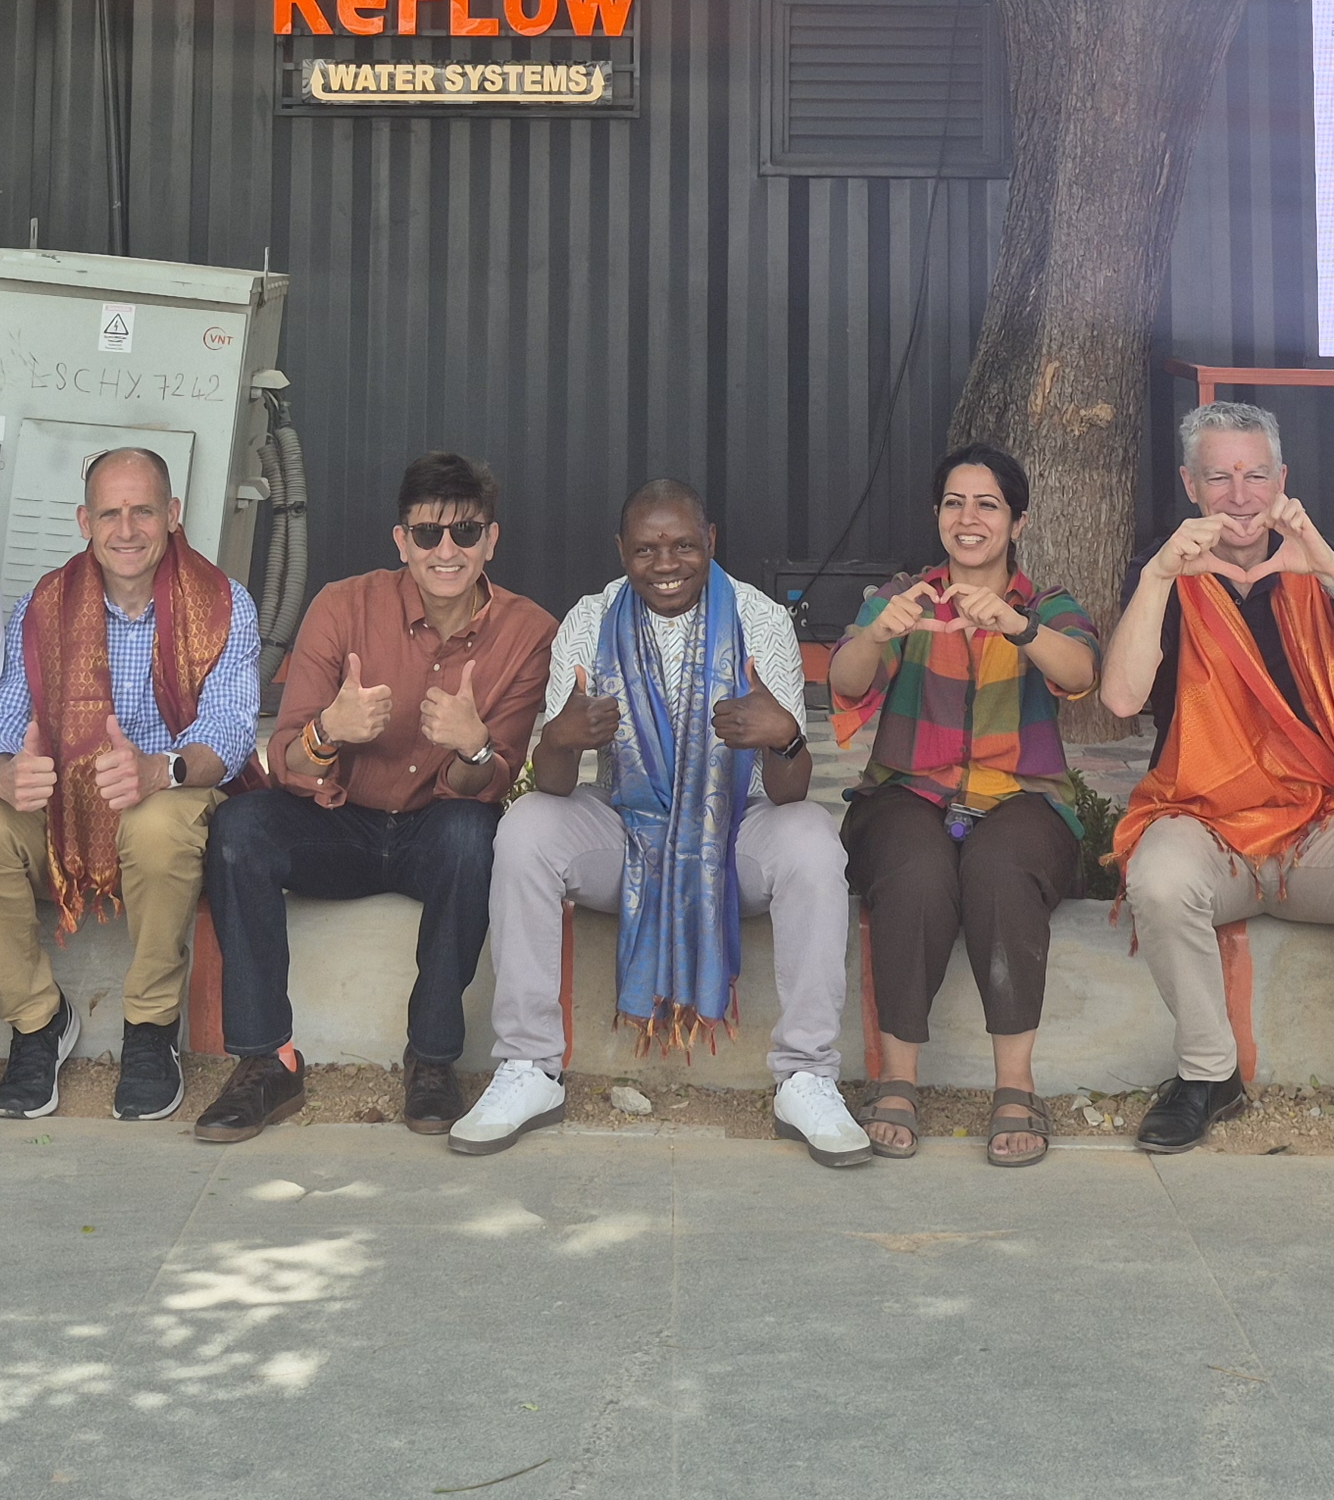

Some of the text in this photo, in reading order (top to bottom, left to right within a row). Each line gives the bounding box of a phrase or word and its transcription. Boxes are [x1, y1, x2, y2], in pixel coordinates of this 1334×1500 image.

[328, 63, 588, 92] WATER SYSTEMS
[210, 334, 234, 346] VNT
